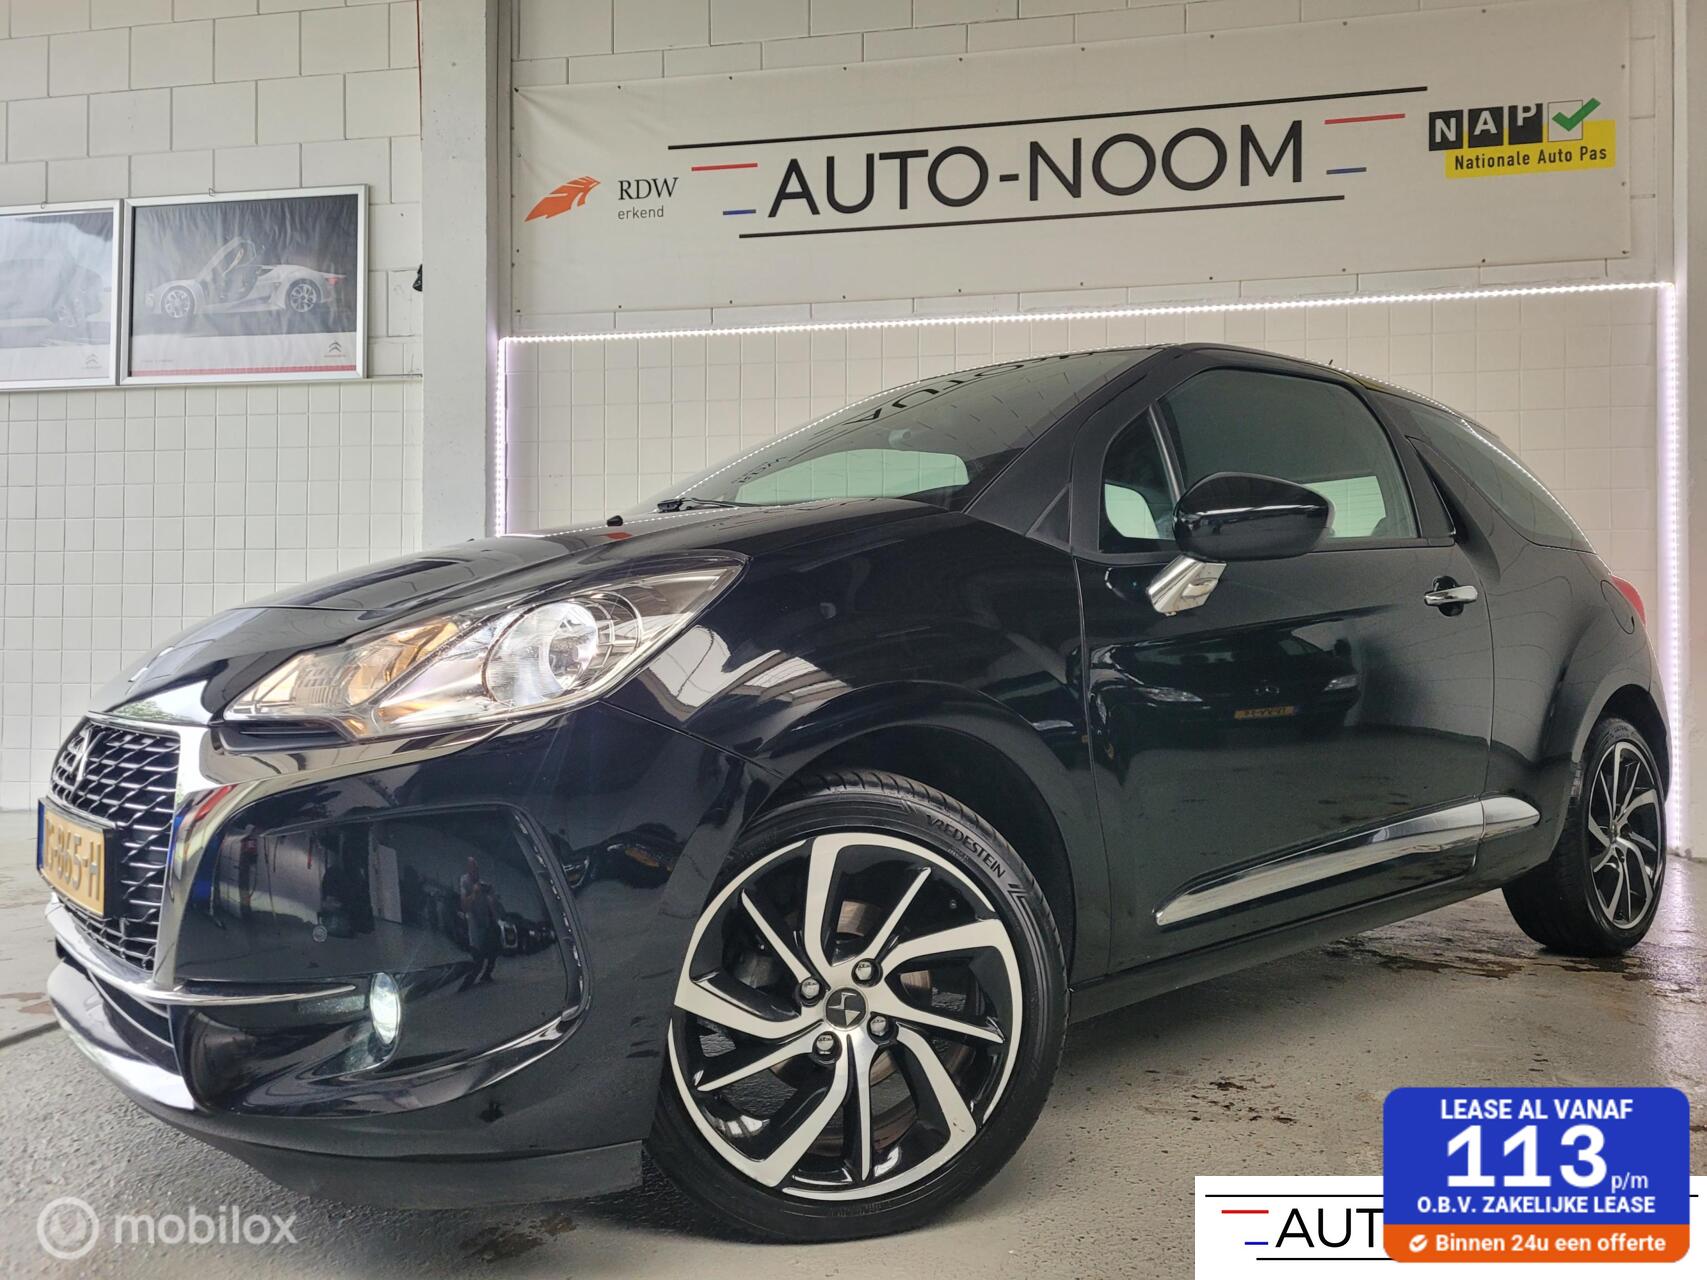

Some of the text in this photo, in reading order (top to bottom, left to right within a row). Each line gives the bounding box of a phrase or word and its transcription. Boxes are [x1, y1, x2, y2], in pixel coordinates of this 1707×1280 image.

[1434, 103, 1538, 144] NAP
[767, 119, 1303, 218] AUTO-NOOM
[1455, 146, 1608, 170] Nationale Auto Pas
[618, 177, 680, 201] RDW
[617, 205, 664, 220] erkend
[926, 814, 1006, 879] VREDESTEIN
